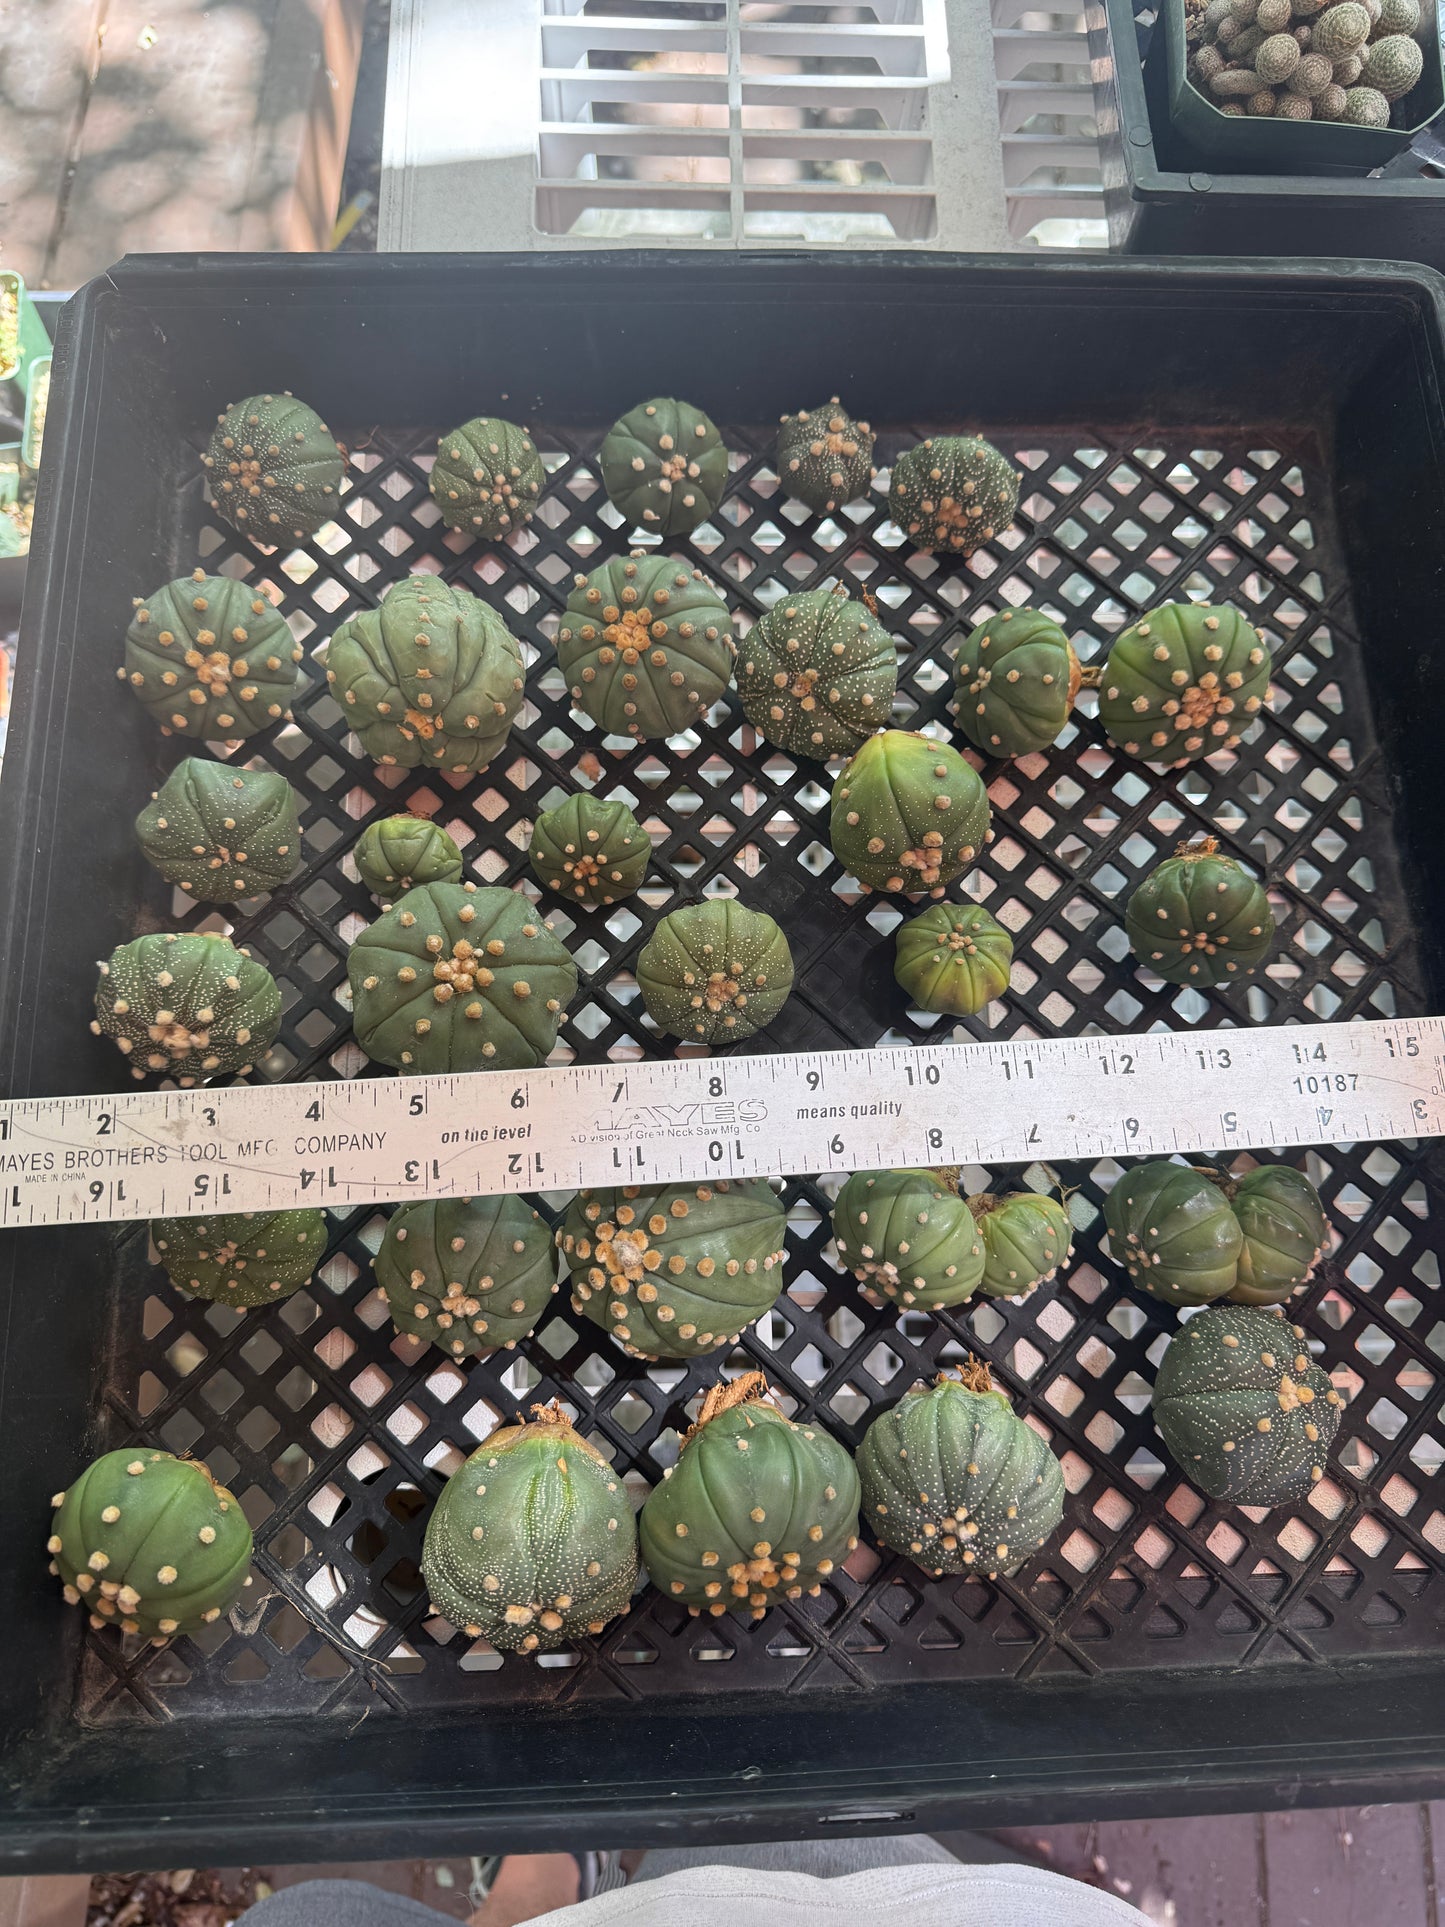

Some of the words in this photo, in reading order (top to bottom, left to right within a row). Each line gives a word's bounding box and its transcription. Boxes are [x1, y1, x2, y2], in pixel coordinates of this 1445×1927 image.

[96, 1113, 112, 1135] 2
[202, 1107, 217, 1127] 3
[304, 1100, 321, 1122] 4
[408, 1094, 424, 1116] 5
[510, 1088, 526, 1110] 6
[708, 1076, 723, 1098] 8
[805, 1070, 821, 1092] 9
[903, 1064, 941, 1086] 10
[1001, 1059, 1035, 1081] 11
[1098, 1053, 1136, 1075] 12
[1195, 1048, 1233, 1070] 13
[1291, 1042, 1328, 1064] 14
[1384, 1036, 1420, 1058] 15
[1293, 1073, 1359, 1095] 10187
[796, 1104, 846, 1120] means
[850, 1100, 903, 1120] quality
[1318, 1106, 1334, 1126] 4
[1412, 1099, 1428, 1120] 3
[696, 1124, 718, 1137] Saw
[1223, 1111, 1238, 1133] 5
[441, 1131, 460, 1144] on
[465, 1127, 489, 1142] the
[493, 1124, 532, 1141] level
[928, 1127, 943, 1149] 8
[1028, 1123, 1043, 1144] 7
[65, 1146, 168, 1169] BROTHERS
[180, 1143, 227, 1164] TOOL
[295, 1131, 388, 1156] COMPANY
[708, 1139, 745, 1162] 10
[404, 1159, 440, 1182] 13
[507, 1152, 545, 1175] 12
[24, 1174, 47, 1184] MADE
[50, 1173, 59, 1182] IN
[61, 1171, 86, 1182] CHINA
[194, 1174, 232, 1197] 15
[299, 1166, 339, 1190] 14
